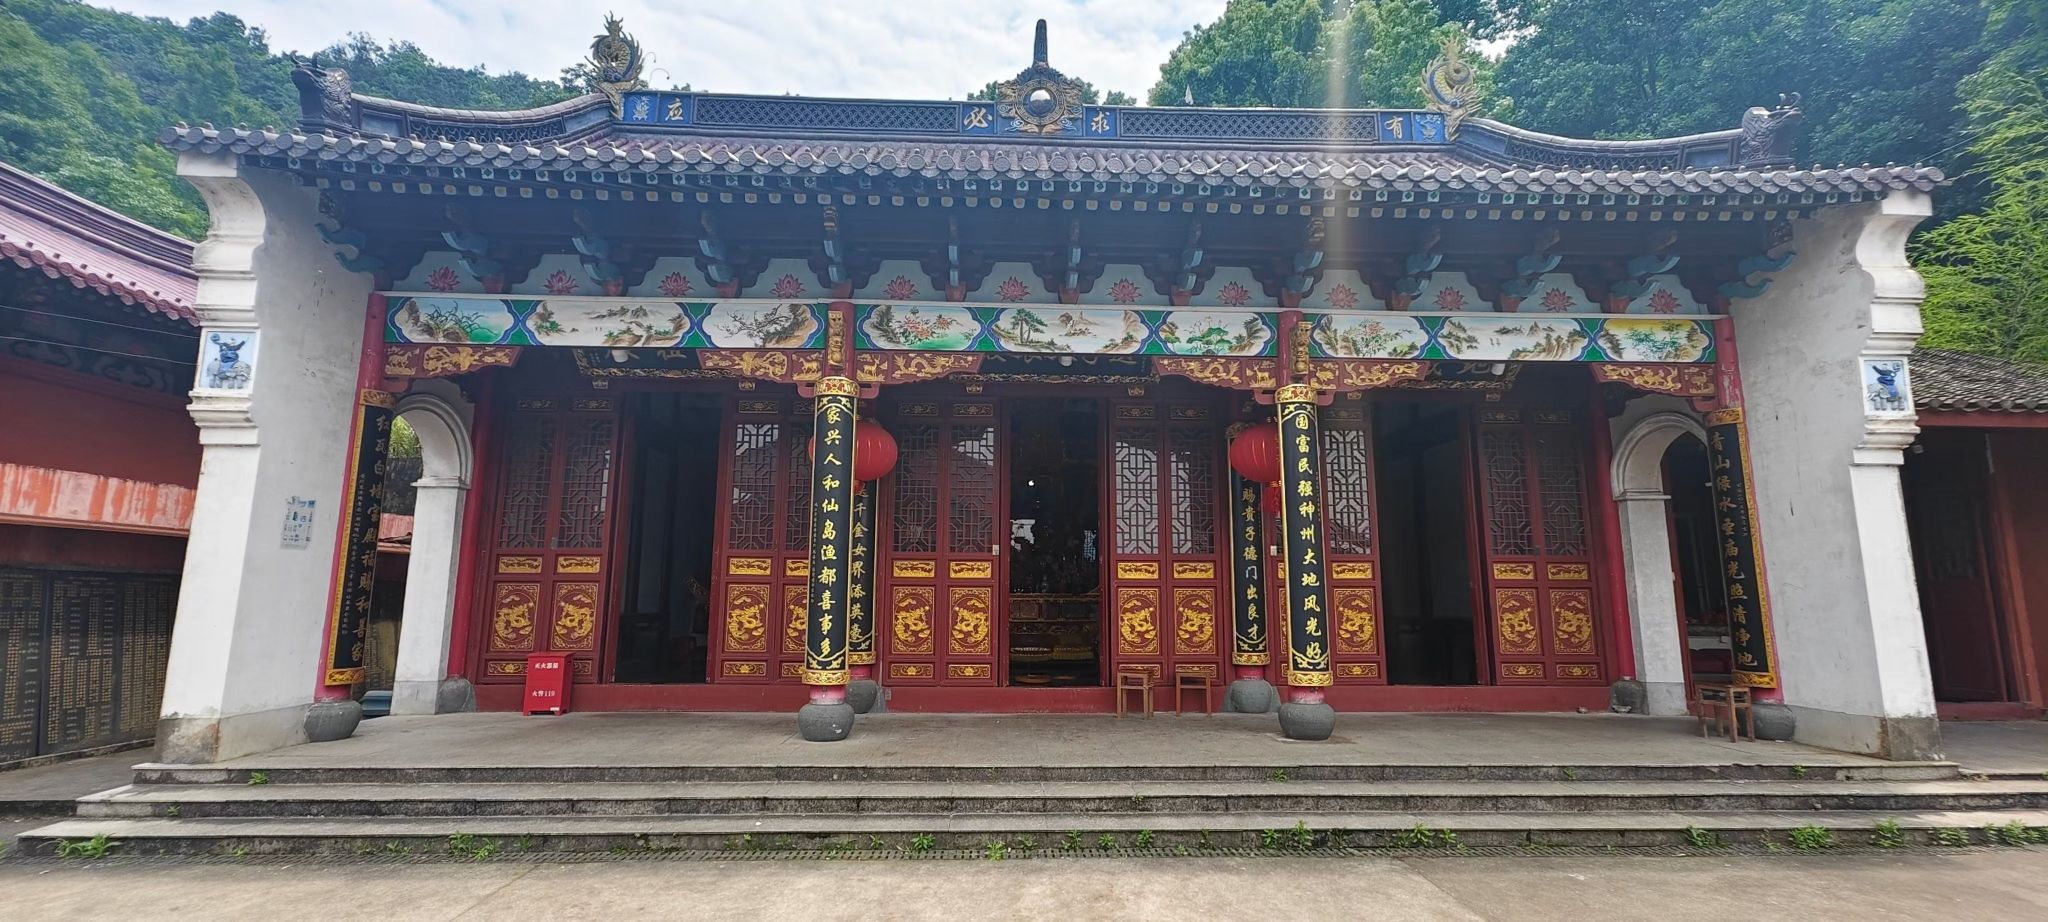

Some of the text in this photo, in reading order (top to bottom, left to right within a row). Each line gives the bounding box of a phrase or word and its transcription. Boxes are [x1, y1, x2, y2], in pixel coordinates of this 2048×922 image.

[665, 98, 1405, 139] 有 求 必 应
[817, 405, 842, 658] 家兴人和仙岛渔都喜事多
[1241, 478, 1259, 640] 赐贵子德门出良才
[1295, 414, 1322, 660] 国富民强神州大地风光好
